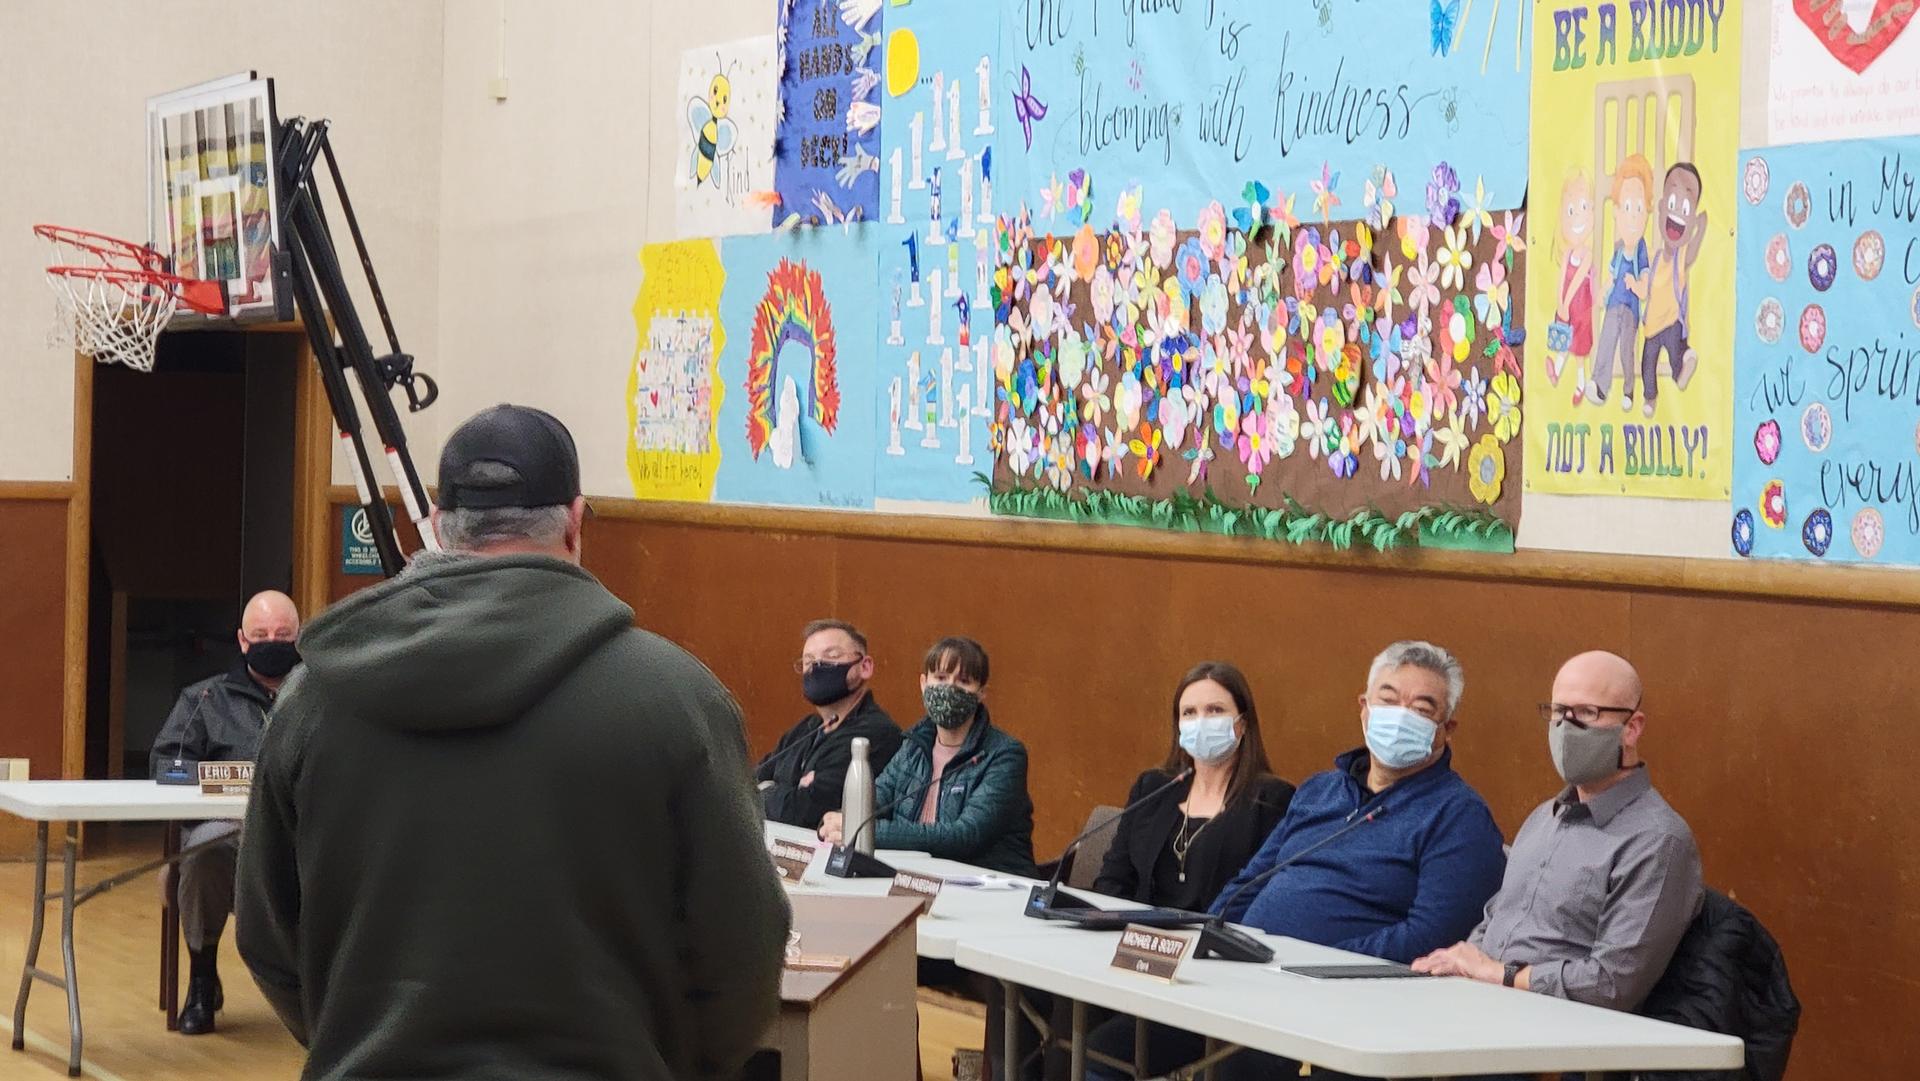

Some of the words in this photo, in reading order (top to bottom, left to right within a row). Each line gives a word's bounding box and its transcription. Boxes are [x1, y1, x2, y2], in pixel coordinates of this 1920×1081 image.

[812, 3, 839, 40] ALL
[1219, 12, 1252, 60] is
[1552, 6, 1588, 72] BE
[1596, 4, 1616, 66] A
[1628, 0, 1725, 63] BUDDY
[800, 43, 854, 84] HANDS
[813, 88, 837, 121] ON
[1080, 67, 1171, 166] blooming
[1199, 66, 1251, 163] with
[801, 132, 848, 170] DECK!
[1829, 171, 1858, 228] in
[1750, 354, 1807, 414] we
[1545, 422, 1591, 473] NOT
[1598, 423, 1615, 475] A
[1623, 424, 1708, 480] BULLY!
[204, 766, 230, 780] ERIC
